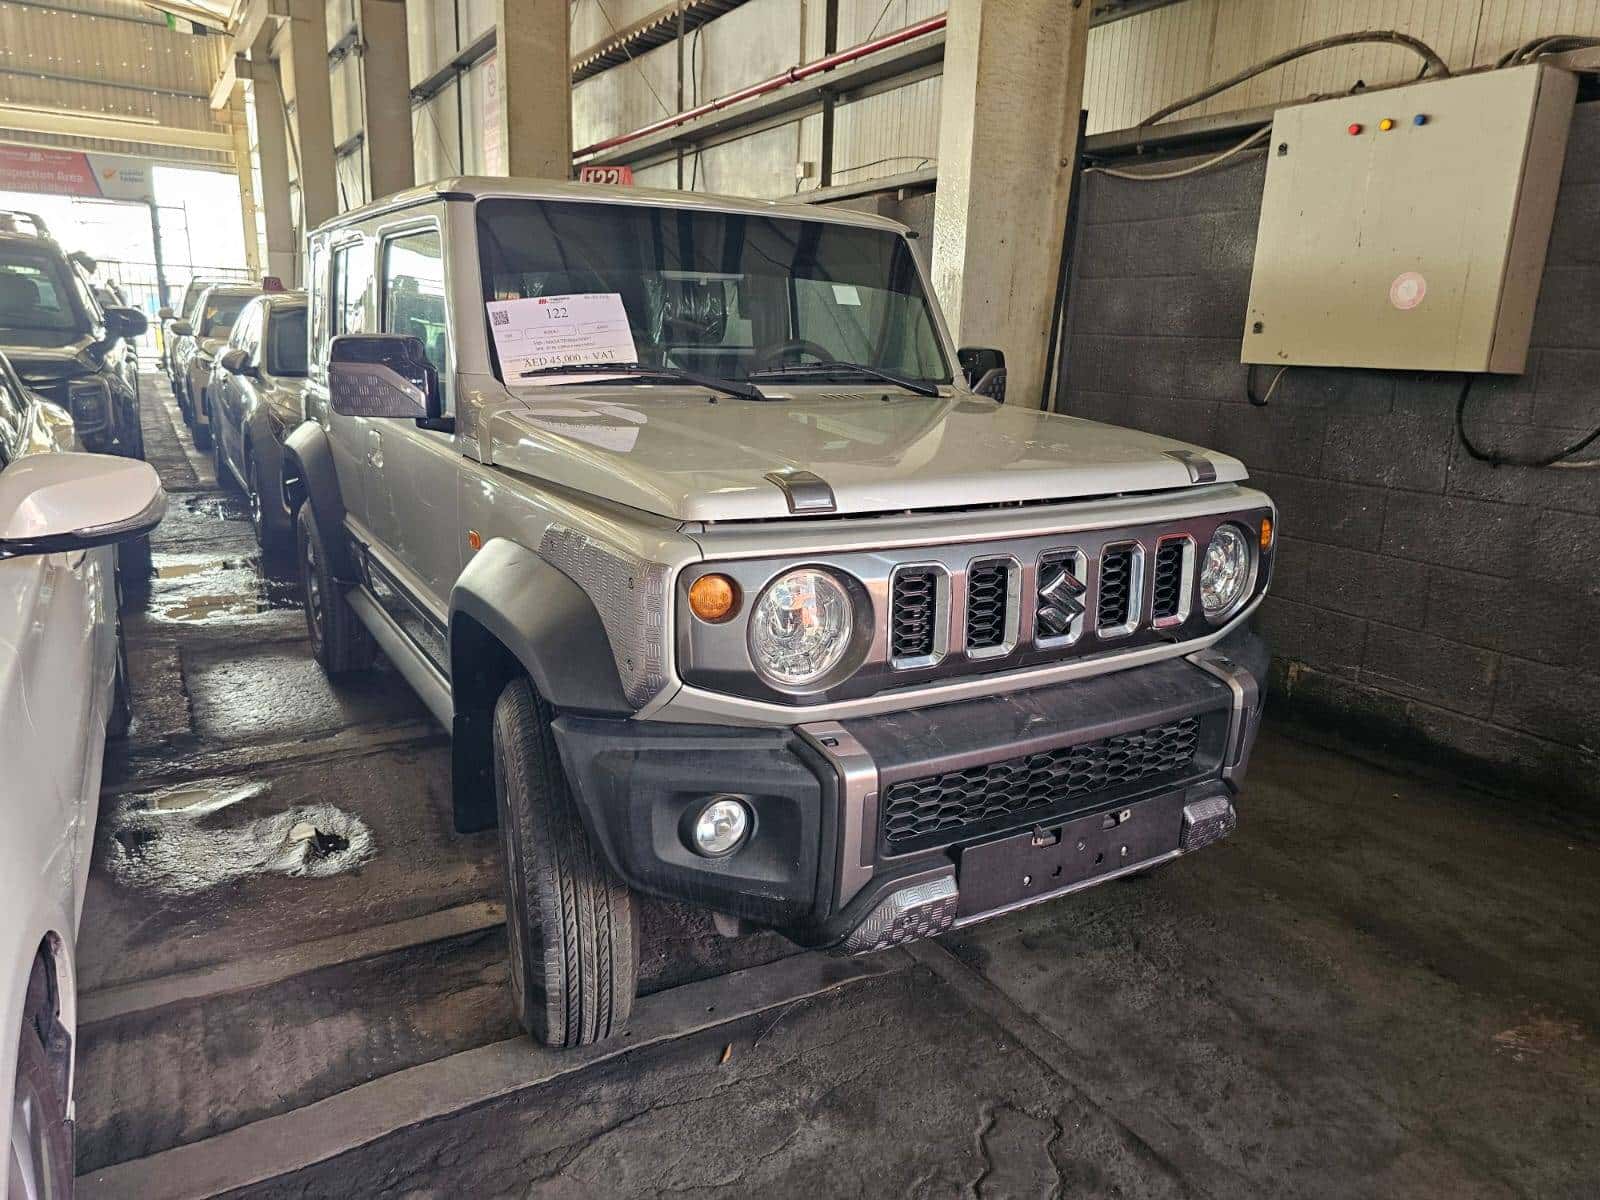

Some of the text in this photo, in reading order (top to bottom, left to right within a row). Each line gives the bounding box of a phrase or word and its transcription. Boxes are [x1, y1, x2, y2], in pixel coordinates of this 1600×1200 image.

[588, 169, 619, 184] 122
[546, 308, 569, 319] 122
[523, 357, 547, 368] AED
[550, 355, 582, 366] 45,000
[592, 350, 616, 360] VAT
